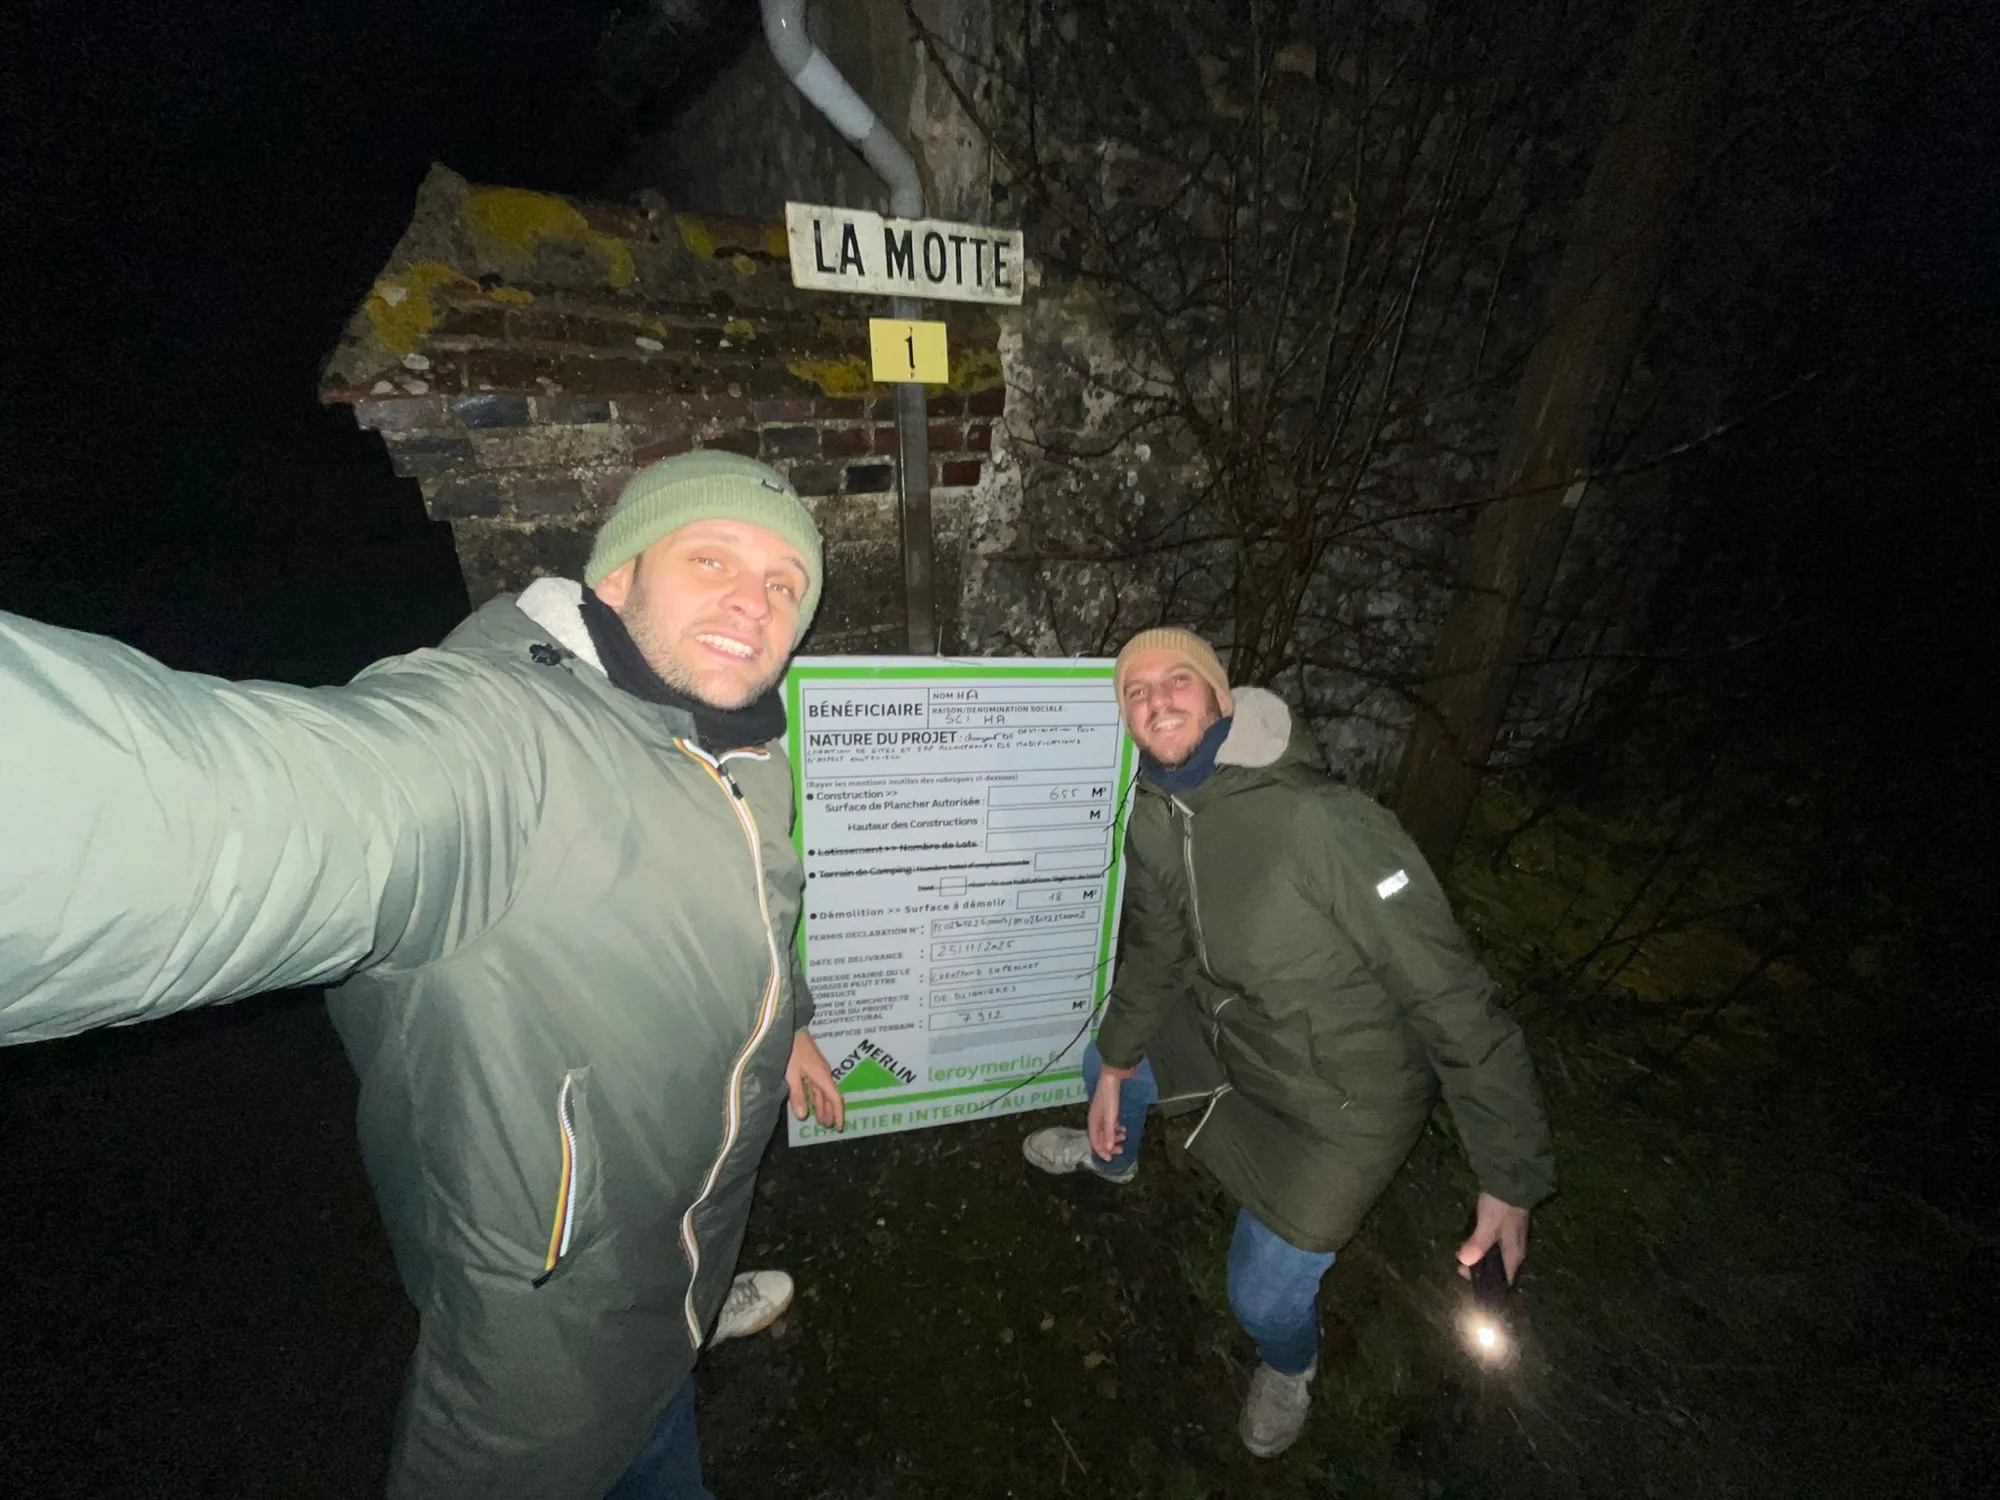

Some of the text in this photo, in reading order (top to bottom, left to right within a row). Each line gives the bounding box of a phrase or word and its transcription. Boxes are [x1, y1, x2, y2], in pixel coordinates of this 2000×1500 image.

[813, 219, 1012, 289] LA MOTTE
[904, 336, 916, 369] 1
[956, 689, 979, 701] HA
[808, 700, 924, 718] BÉNÉFICIAIRE
[932, 705, 1063, 715] RAISON/DENOMINATION SOCIALE
[984, 714, 1006, 725] HA
[810, 731, 958, 747] NATURE DU PROJET
[835, 780, 847, 788] les
[848, 779, 887, 787] mentions
[888, 778, 919, 786] inutiles
[920, 777, 934, 785] des
[936, 776, 974, 785] rubriques
[816, 790, 884, 801] Construction
[825, 798, 980, 813] Surface de Plancher Autorisée
[1089, 809, 1101, 820] M
[848, 817, 978, 832] Hauteur des Constructions
[819, 908, 885, 920] Démolition
[904, 903, 949, 913] Surface
[953, 901, 959, 910] à
[963, 899, 1006, 909] démolir
[809, 933, 844, 942] PERMIS
[845, 928, 908, 939] DECLARATION
[809, 952, 904, 967] DATE DE DELIVRANCE
[810, 974, 850, 983] ADRESSE
[853, 970, 884, 979] MAIRIE
[810, 978, 896, 992] DOSSIER PEUT ETRE
[848, 1006, 861, 1014] DU
[862, 1003, 894, 1013] PROJET
[864, 1027, 877, 1035] DU
[878, 1023, 915, 1033] TERRAIN
[831, 1038, 917, 1085] ROY MERLIN
[799, 1084, 1088, 1139] CHNTIER INTERDIT AU PUBLI
